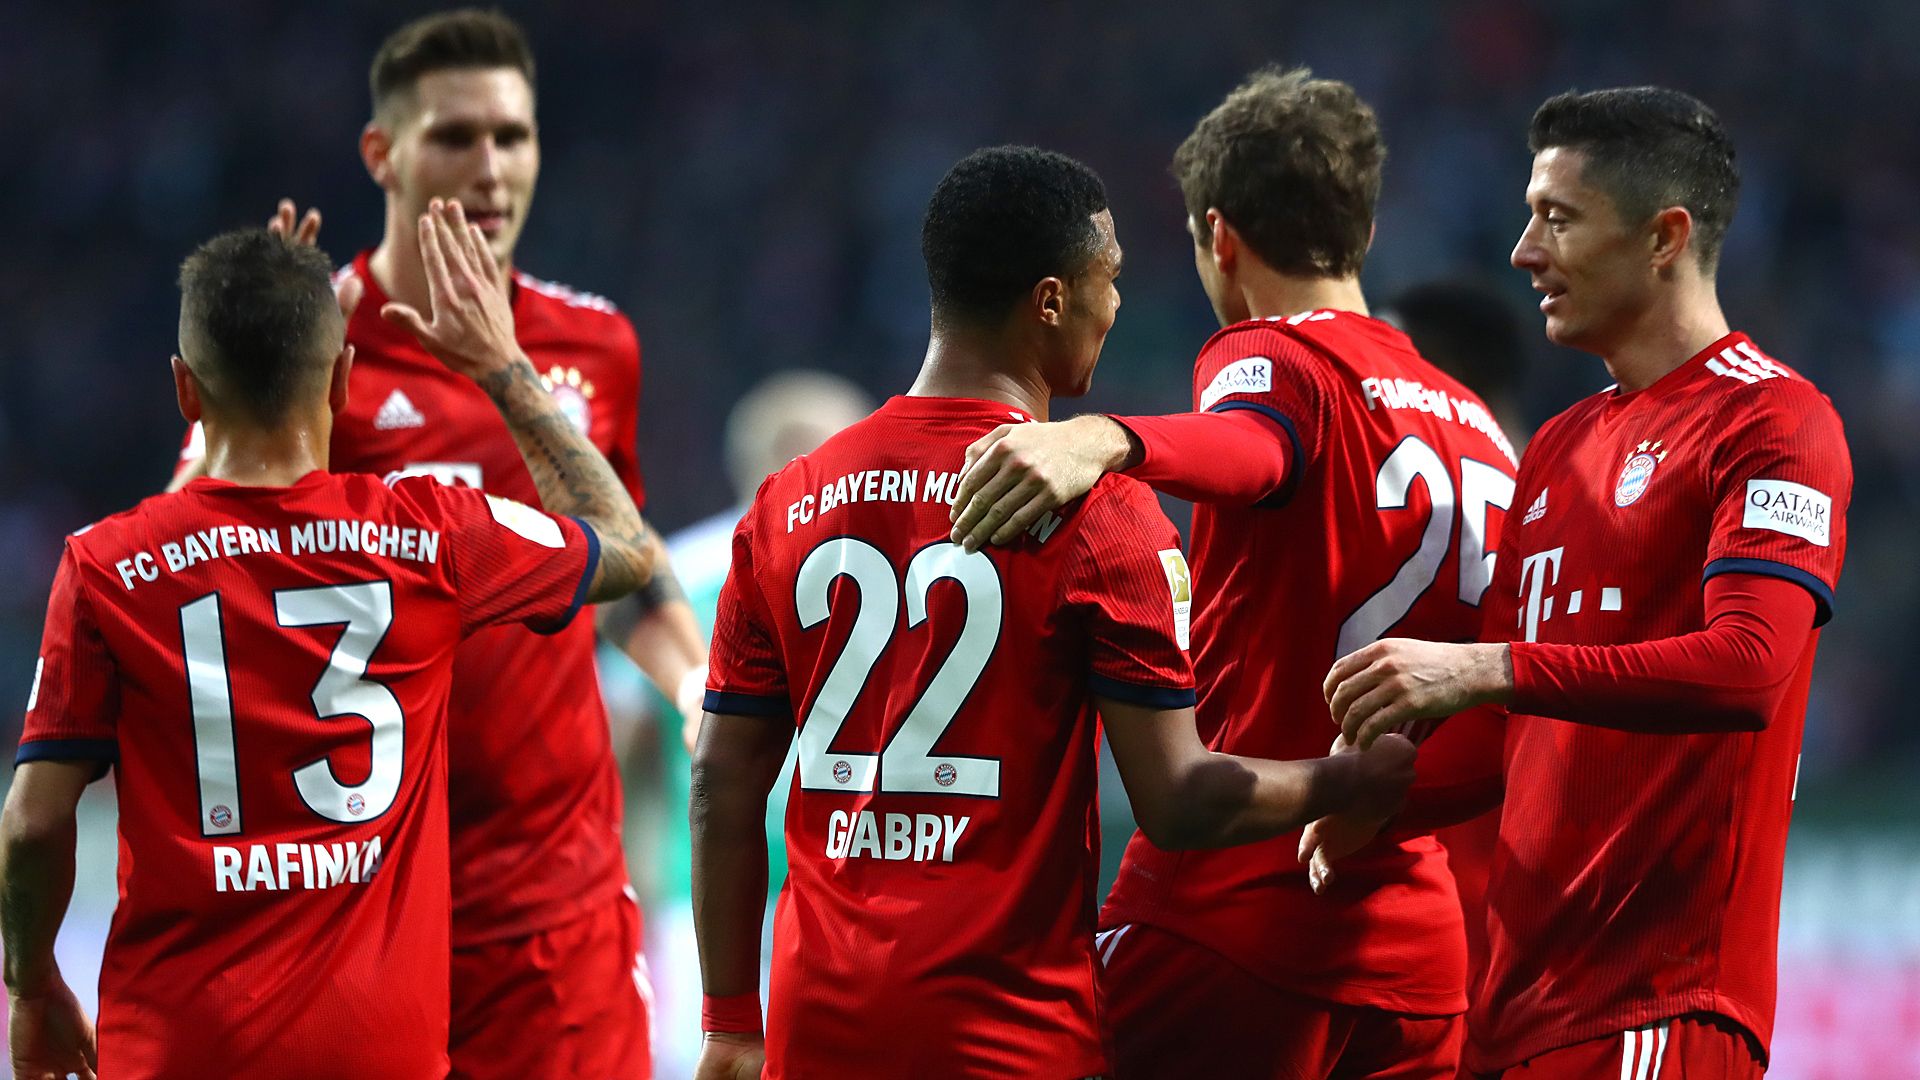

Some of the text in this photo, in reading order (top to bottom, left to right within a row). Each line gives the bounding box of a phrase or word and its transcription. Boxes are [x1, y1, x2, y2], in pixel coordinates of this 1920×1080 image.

[787, 494, 815, 533] FC
[819, 469, 919, 515] BAYERN
[1750, 489, 1825, 524] QATAR
[1770, 510, 1825, 537] AIRWAYS
[115, 520, 440, 591] FC BAYERN MÜNCHEN
[1335, 434, 1518, 661] 25
[795, 535, 1003, 799] 22
[180, 580, 406, 837] 13
